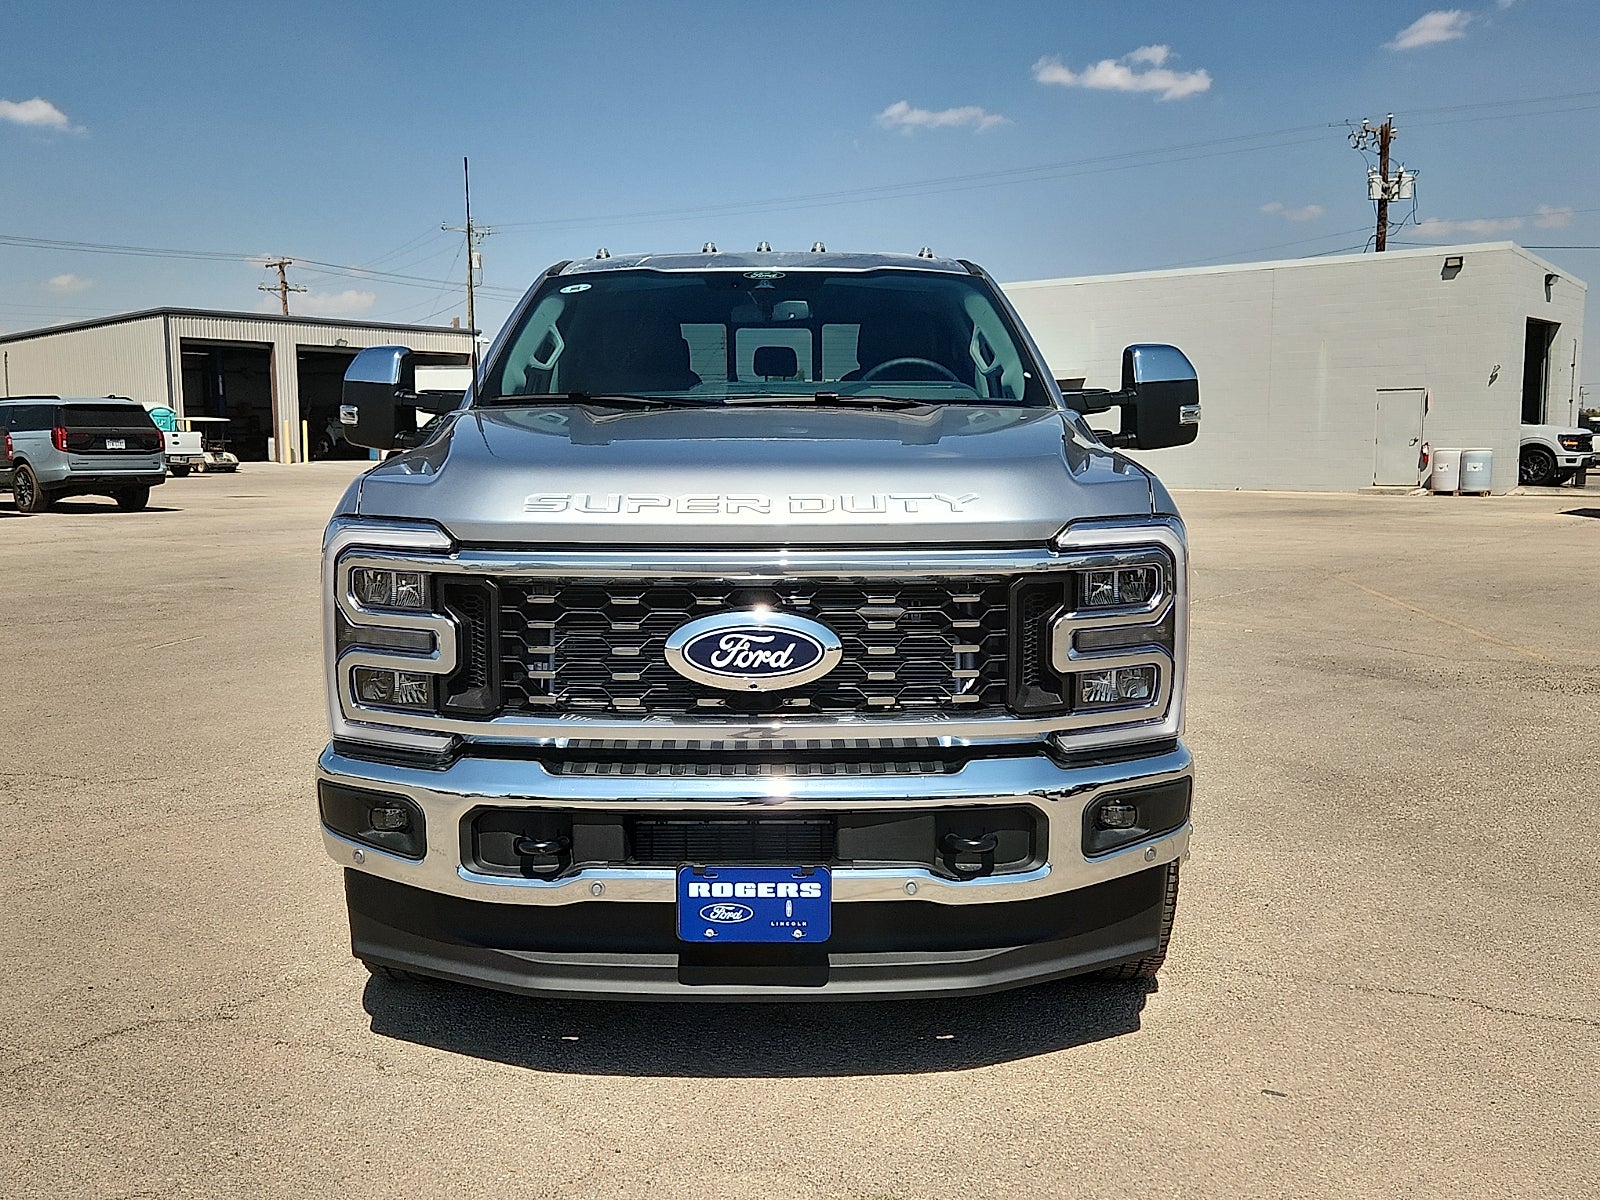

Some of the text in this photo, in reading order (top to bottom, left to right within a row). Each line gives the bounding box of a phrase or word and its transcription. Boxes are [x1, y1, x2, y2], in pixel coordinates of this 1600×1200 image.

[524, 493, 980, 515] SUPER DUTY
[710, 633, 797, 669] Ford
[688, 882, 822, 898] ROGERS
[709, 905, 743, 920] Ford
